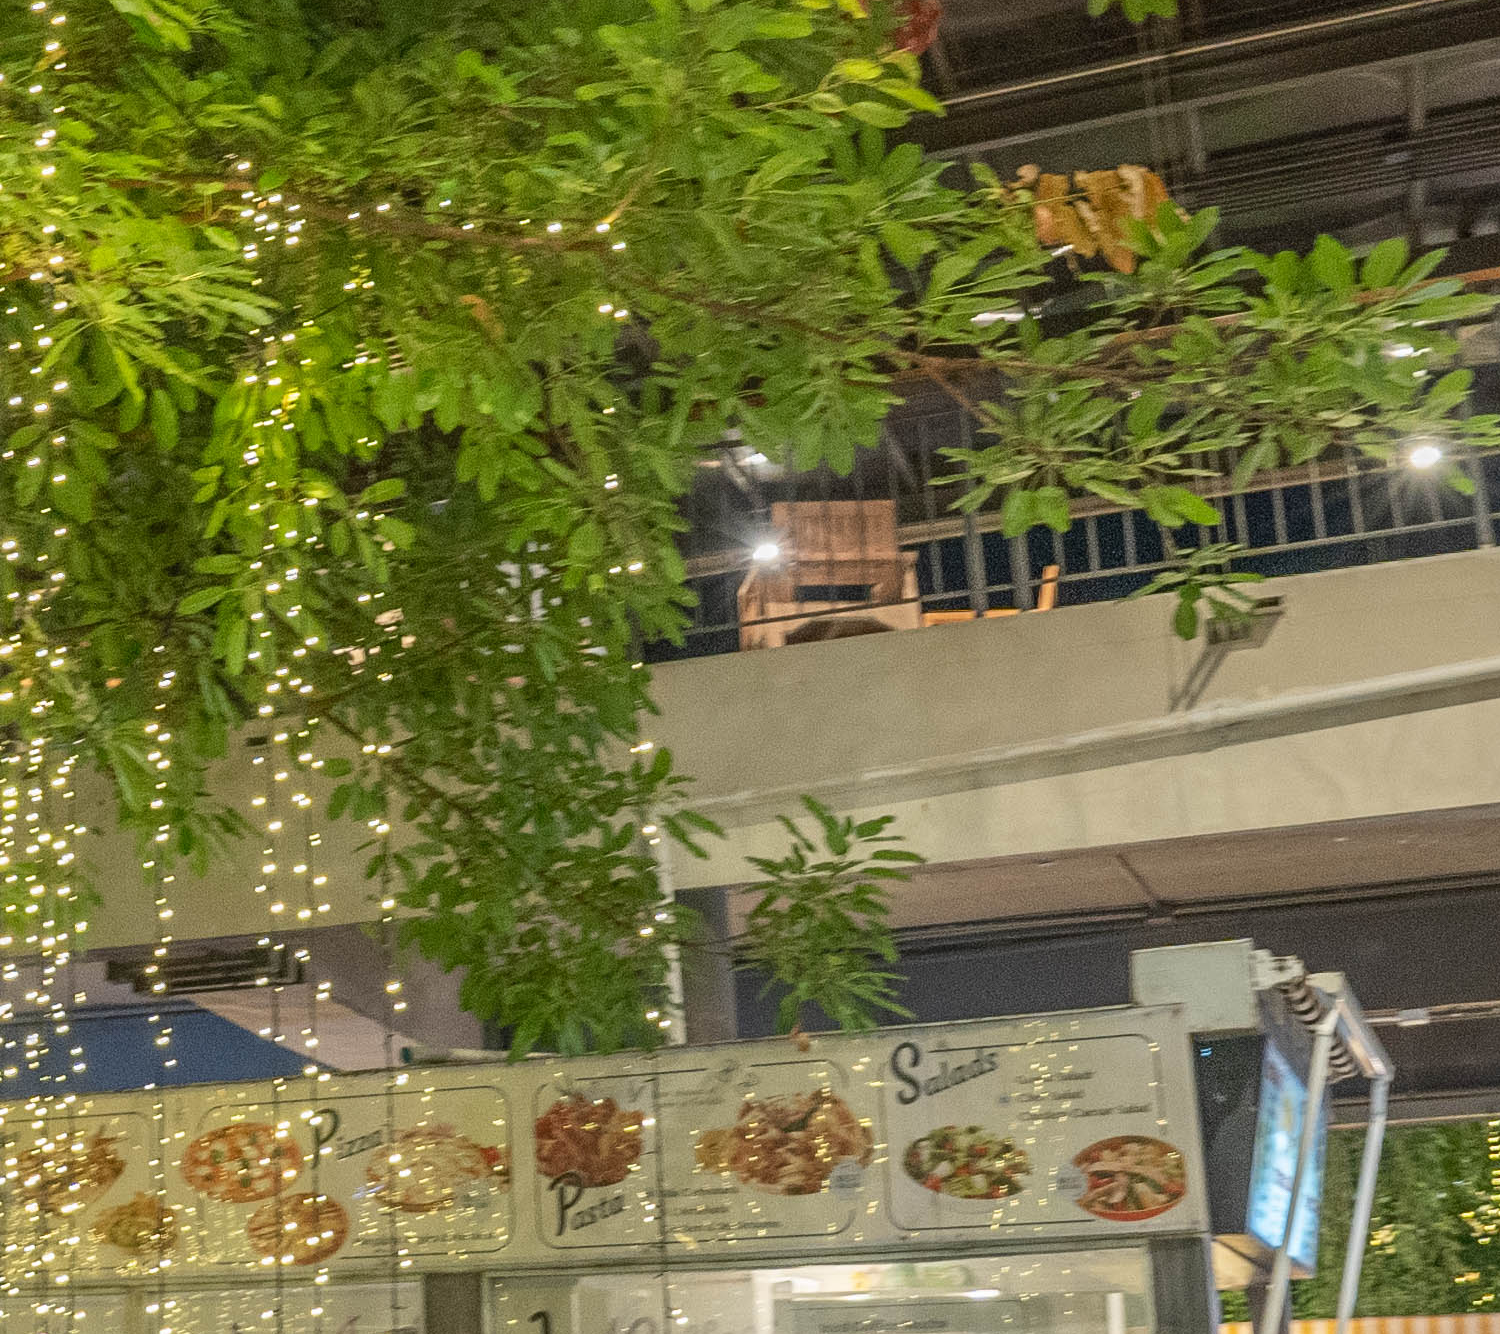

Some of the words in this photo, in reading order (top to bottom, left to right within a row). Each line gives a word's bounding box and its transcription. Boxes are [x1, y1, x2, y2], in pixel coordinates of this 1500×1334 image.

[890, 1041, 999, 1105] Salads
[304, 1107, 384, 1169] Pizza
[549, 1169, 625, 1237] Pasta
